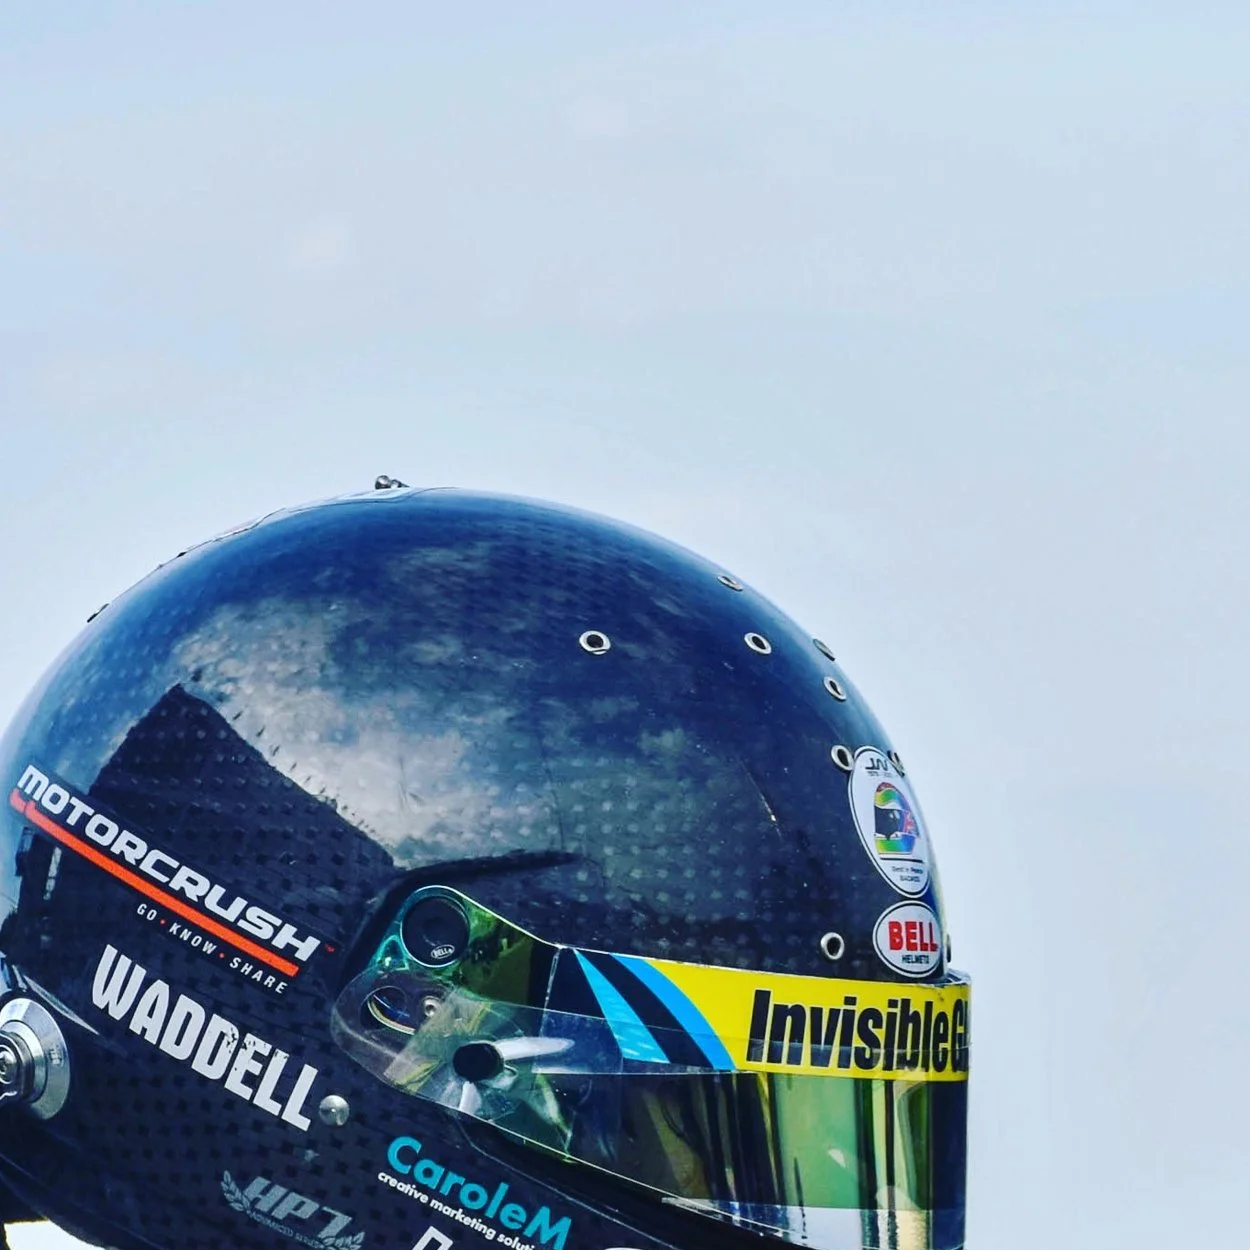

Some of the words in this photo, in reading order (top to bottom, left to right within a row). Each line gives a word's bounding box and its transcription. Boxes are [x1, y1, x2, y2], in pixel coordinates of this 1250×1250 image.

[17, 764, 321, 962] MOTORCRUSH
[137, 903, 158, 922] GO
[169, 922, 218, 955] KNOW
[229, 957, 288, 995] SHARE
[888, 921, 938, 952] BELL
[91, 944, 319, 1132] WADDELL
[746, 989, 969, 1073] InvisibleG
[243, 1176, 352, 1239] HP7
[377, 1172, 429, 1204] creative
[429, 1198, 496, 1241] marketing
